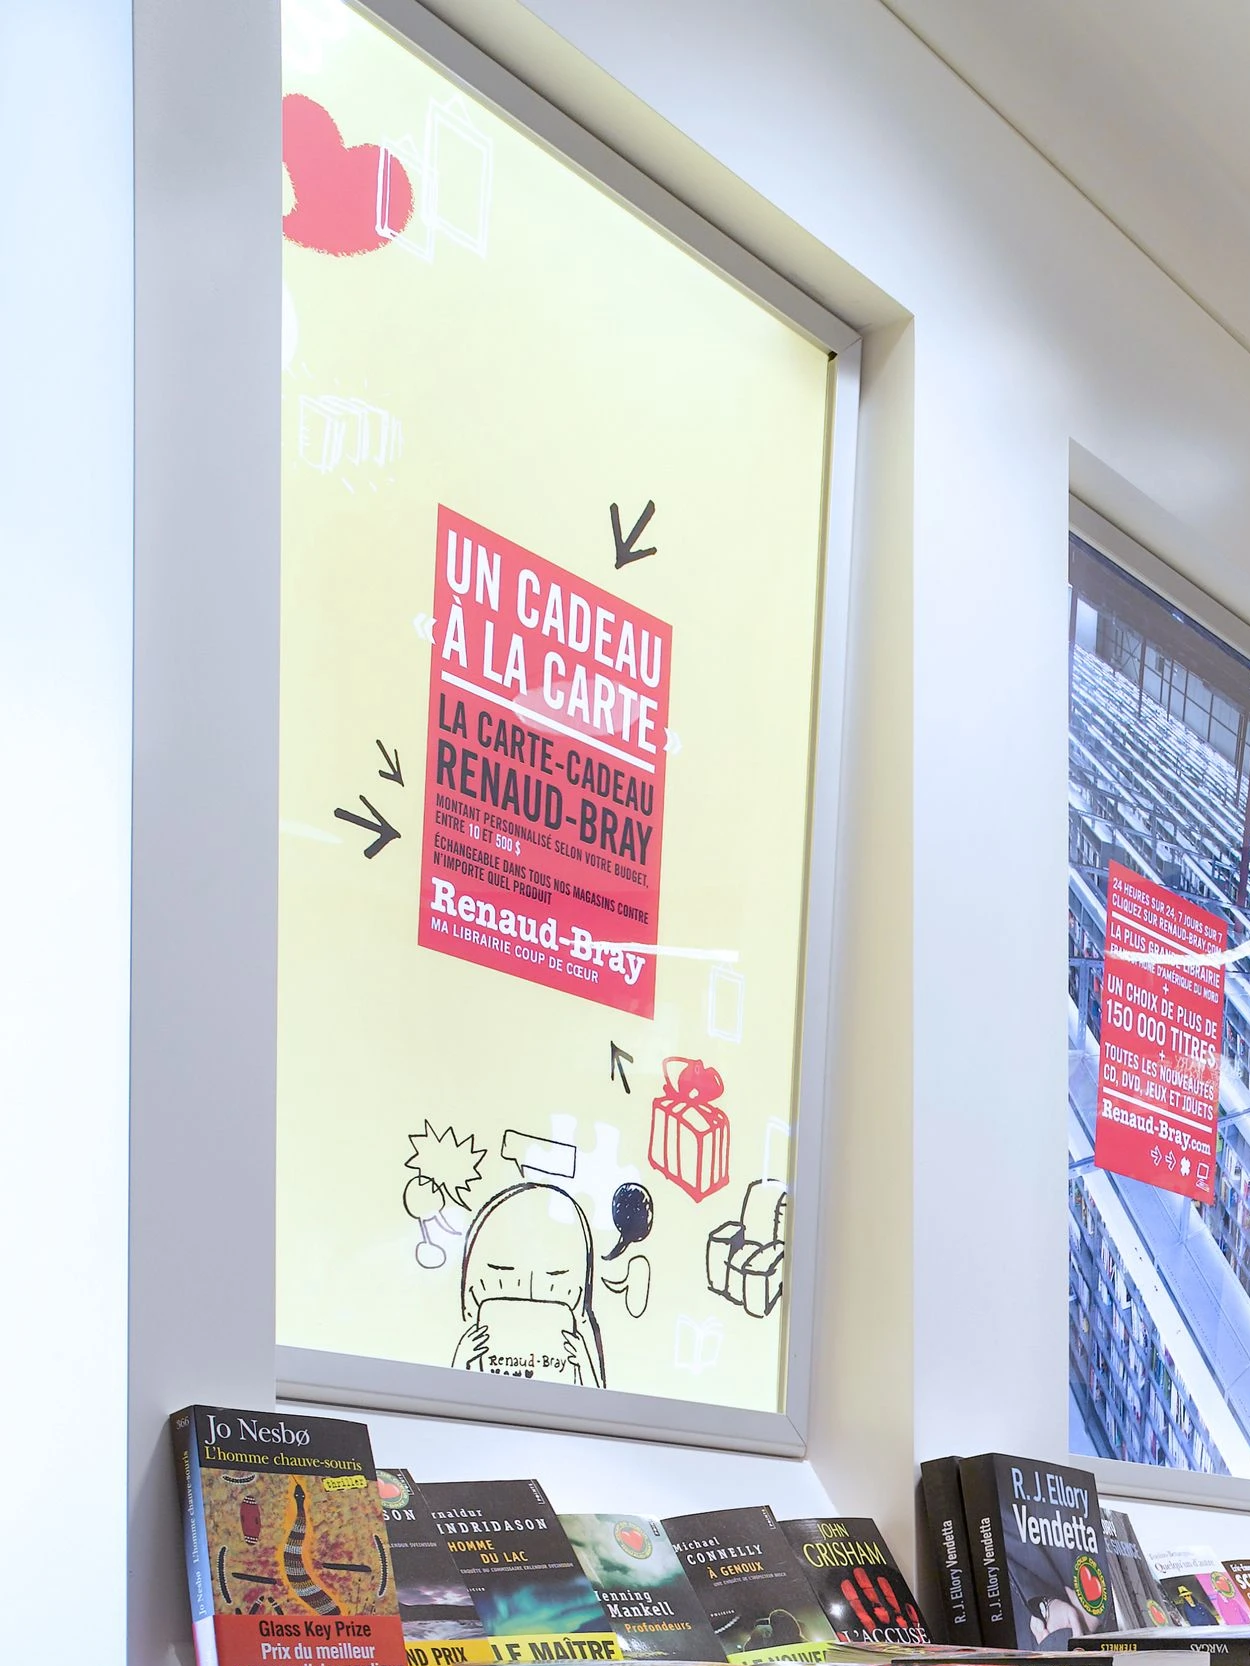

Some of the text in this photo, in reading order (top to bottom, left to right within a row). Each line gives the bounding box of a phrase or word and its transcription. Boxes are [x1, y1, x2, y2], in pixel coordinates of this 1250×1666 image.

[446, 529, 661, 688] UN CADEAU
[441, 595, 657, 754] À LA CARTE
[438, 693, 654, 816] LA CARTE-CADEAU
[437, 738, 653, 866] RENAUD-BRAY
[435, 811, 521, 856] ENTRE 10 ET 500 $
[436, 793, 649, 889] MONTANT PERSONNALISÉ SELON VOTRE BUDGET.
[433, 850, 552, 906] N'IMPORTE QUEL PRODUIT
[434, 832, 648, 925] ÉCHANGEABLE DANS TOUS NOS MAGASINS CONTRE
[430, 876, 646, 985] Renaud-Bray
[1112, 878, 1123, 892] 24
[1124, 884, 1150, 905] HEURES
[1151, 897, 1165, 915] SUR
[1178, 911, 1183, 923] 7
[1183, 914, 1203, 934] JOURS
[1204, 923, 1217, 940] SUR
[1217, 930, 1223, 944] 7
[1112, 894, 1222, 954] CLIQUEZ SUR RENAUD-BRAY.COM
[431, 916, 599, 983] MA LIBRAIRIE COUP DE CŒUR
[1110, 922, 1220, 988] LA PLUS LIBRAIRIE
[1108, 974, 1217, 1040] UN CHOIX DE PLUS DE
[1157, 965, 1219, 1004] D'AMÉRIQUE DU NORD
[1107, 999, 1216, 1069] 150 000 TITRES
[1104, 1064, 1213, 1120] CD, DVD, JEUX ET JOUETS
[1105, 1042, 1214, 1101] TOUTES LES NOUVEAUTÉS
[1102, 1098, 1211, 1156] Renaud-Bray.com
[488, 1354, 566, 1373] Renaud-Bray
[205, 1415, 311, 1447] Jo Nesbø
[204, 1446, 363, 1472] L'homme chauve-souris
[183, 1450, 200, 1564] L'homme chauve-souris
[326, 1478, 366, 1489] thriller
[1011, 1467, 1089, 1518] R. J. Ellory
[437, 1518, 547, 1535] INDRIDASON
[672, 1536, 720, 1553] Michael
[817, 1523, 849, 1541] JOHN
[1012, 1503, 1099, 1554] Vendetta
[480, 1551, 528, 1563] DU LAC
[686, 1545, 764, 1565] CONNELLY
[708, 1561, 764, 1579] À GENOUX
[803, 1542, 887, 1568] GRISHAM
[942, 1520, 963, 1600] Ellory Vendetta
[980, 1517, 1000, 1600] Ellory Vendetta
[258, 1620, 372, 1641] Glass Key Prize
[608, 1602, 675, 1618] Mankell
[625, 1622, 692, 1633] Profondeurs
[843, 1622, 931, 1644] L'ACCUSÉ
[261, 1643, 375, 1660] Prix du meilleur
[432, 1646, 468, 1666] PRIX
[531, 1637, 615, 1661] MAÎTRE
[1100, 1643, 1137, 1652] ETERNELS
[1190, 1643, 1229, 1653] VARGAS
